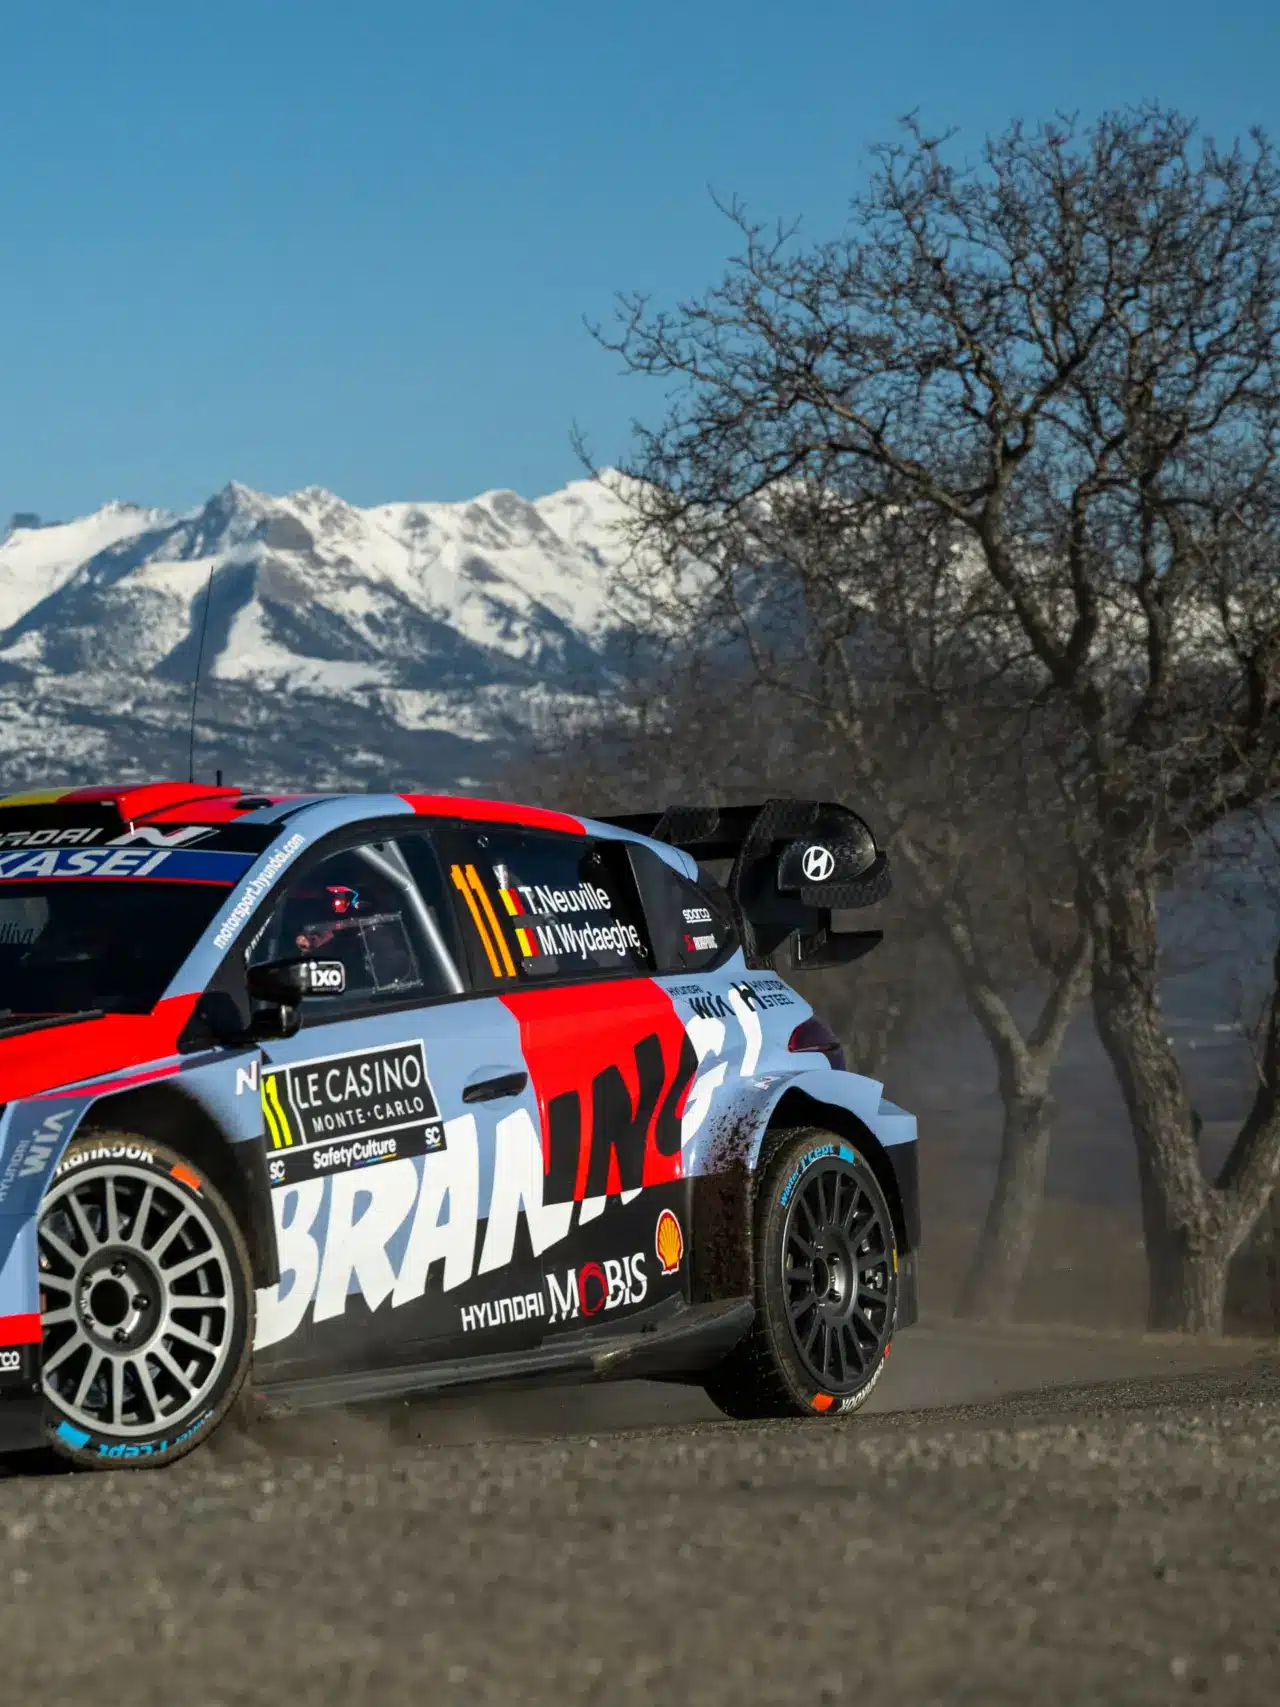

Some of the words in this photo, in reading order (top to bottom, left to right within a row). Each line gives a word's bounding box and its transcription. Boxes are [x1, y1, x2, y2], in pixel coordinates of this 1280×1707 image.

[213, 833, 306, 949] motorsport.hyundai.com
[518, 882, 612, 915] T.Neuville
[450, 864, 516, 977] 11
[536, 919, 641, 960] M.Wydaeghe
[760, 993, 794, 1007] STEEL
[294, 1073, 322, 1109] LE
[325, 1055, 420, 1103] CASINO
[313, 1138, 397, 1169] SafetyCulture
[425, 1126, 441, 1146] SC
[460, 1292, 545, 1332] HYUNDAI
[545, 1252, 648, 1325] MOBIS
